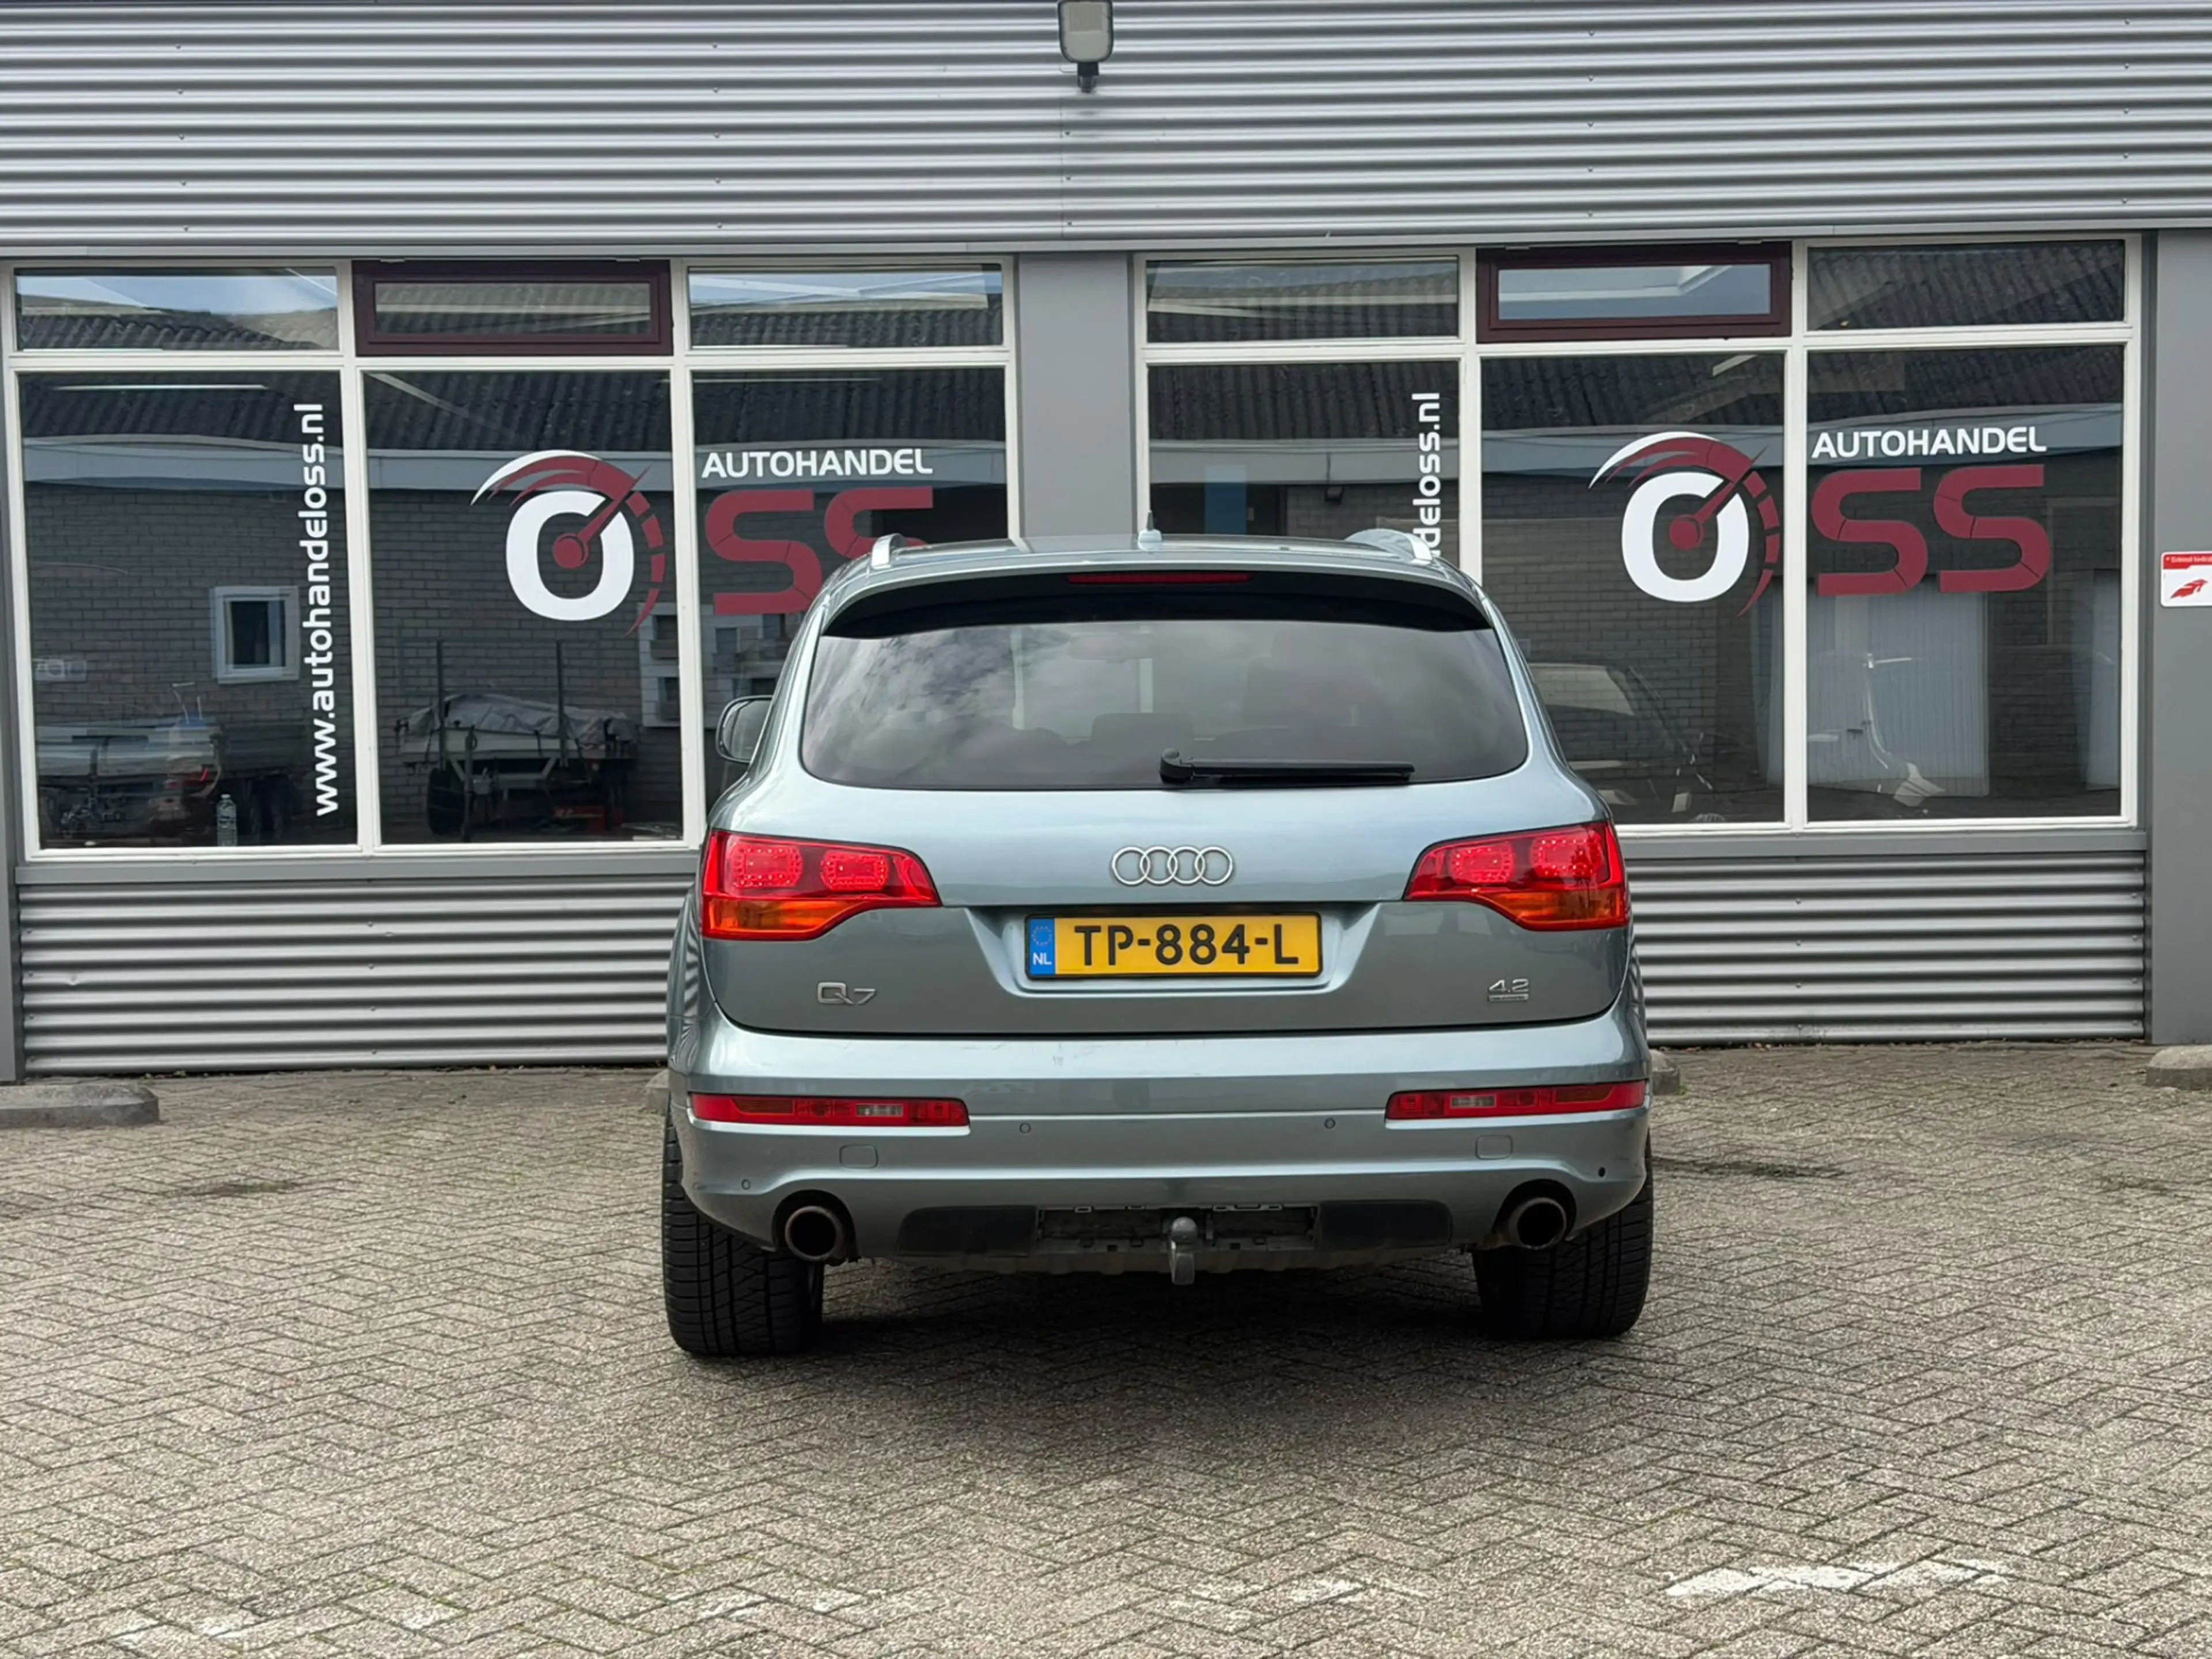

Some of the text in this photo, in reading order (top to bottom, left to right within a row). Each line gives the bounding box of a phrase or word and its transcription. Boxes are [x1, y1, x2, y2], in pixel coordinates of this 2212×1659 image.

[1811, 426, 2047, 459] AUTOHANDEL
[702, 449, 933, 479] AUTOHANDEL
[1412, 393, 1441, 556] deloss.nl
[294, 404, 338, 816] www.autohandeloss.nl
[1033, 952, 1052, 965] NL
[1074, 923, 1299, 965] TP-884-L
[818, 982, 876, 1004] Q7
